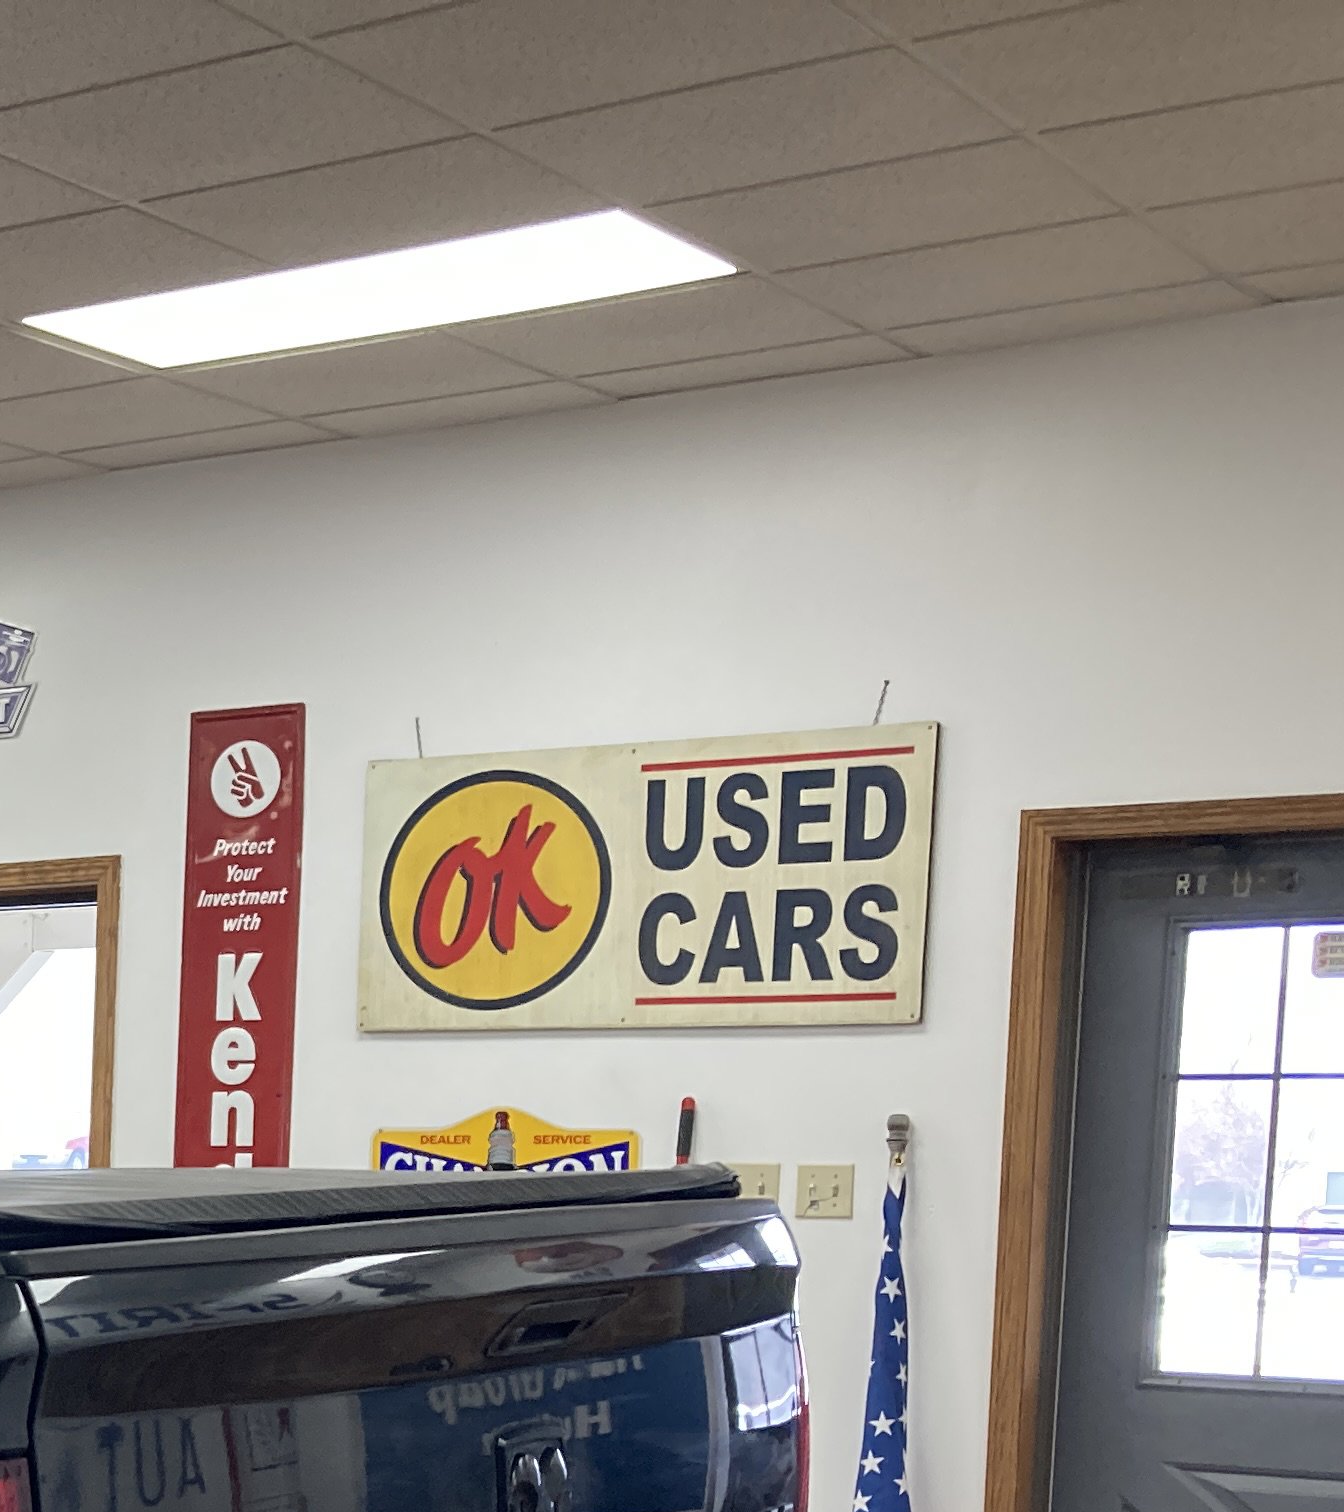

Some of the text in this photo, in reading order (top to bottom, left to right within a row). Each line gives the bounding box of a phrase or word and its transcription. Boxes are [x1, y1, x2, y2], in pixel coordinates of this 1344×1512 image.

[644, 765, 908, 871] USED
[213, 837, 277, 857] Protect
[226, 864, 263, 883] Your
[196, 887, 289, 908] Investment
[412, 804, 573, 970] OK
[223, 913, 262, 932] with
[638, 884, 900, 987] CARS
[210, 951, 264, 1168] Ken
[420, 1134, 592, 1145] DEALER SERVICE
